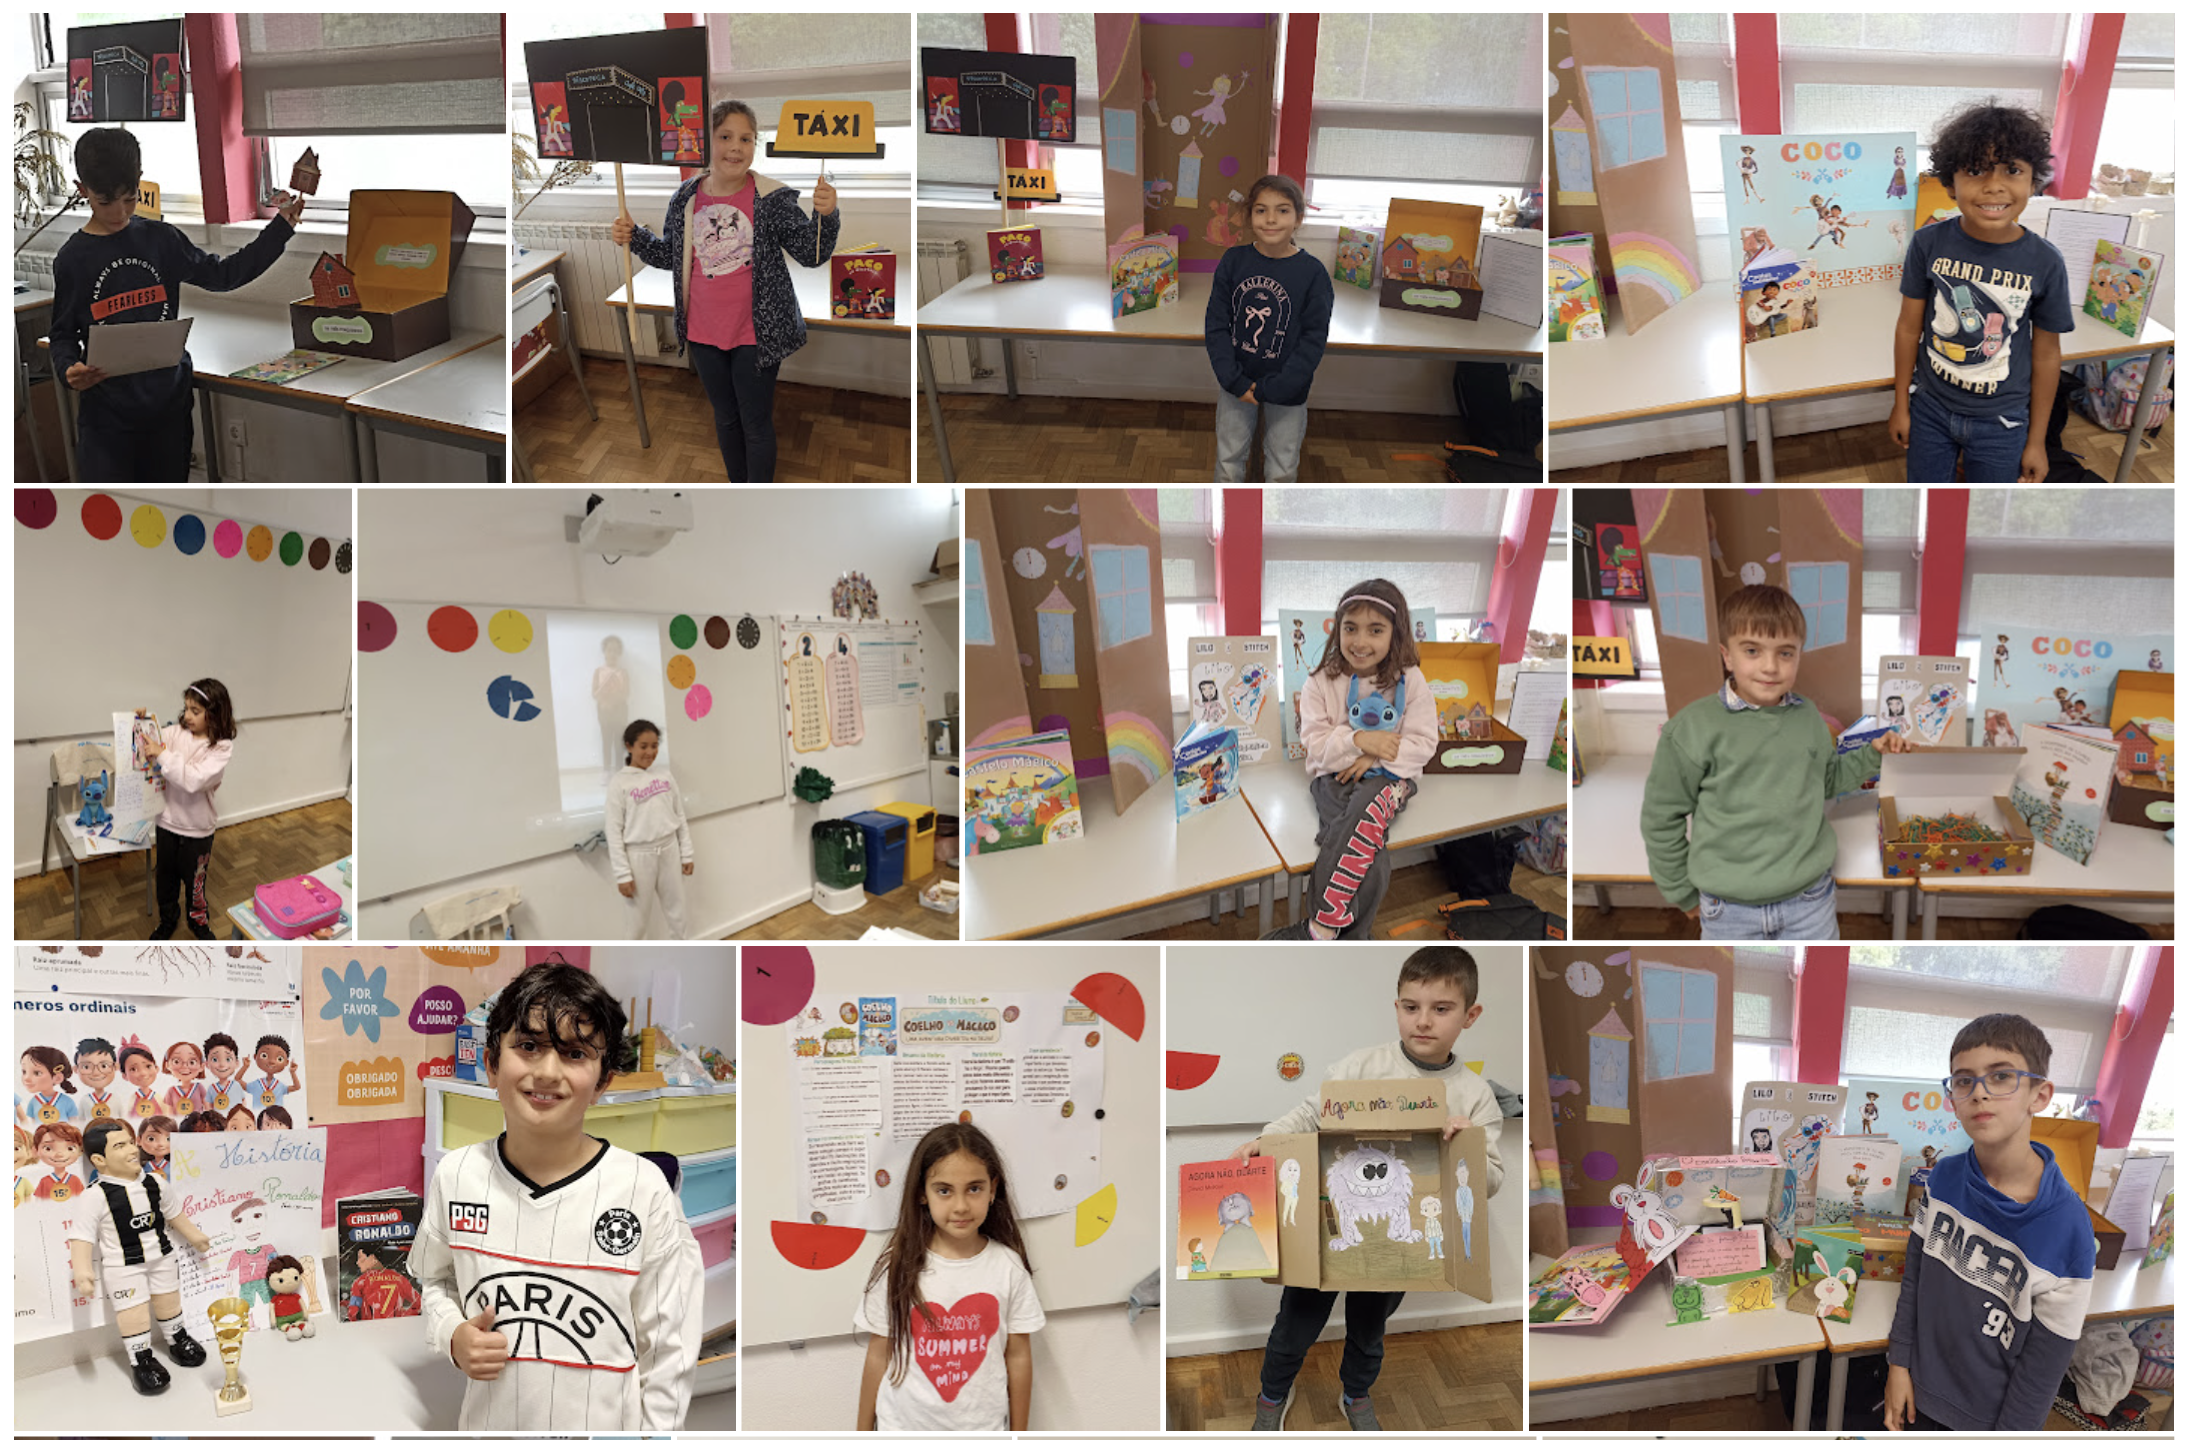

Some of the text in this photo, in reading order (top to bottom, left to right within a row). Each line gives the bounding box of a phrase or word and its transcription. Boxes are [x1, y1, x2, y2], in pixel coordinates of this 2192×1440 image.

[793, 109, 859, 137] TÁXI
[1781, 141, 1862, 162] COCO
[137, 189, 155, 208] AXI
[999, 233, 1032, 245] PACO
[843, 259, 883, 271] PACO
[93, 258, 161, 300] ALWAYS BE ORIGINAL
[1931, 257, 2033, 292] GRAND PRIX
[1240, 276, 1288, 302] BALLERINA
[1783, 278, 1810, 290] COCO
[107, 289, 156, 313] FEARLESS
[1930, 358, 1999, 395] WINNER
[802, 635, 848, 656] 2 4
[2031, 636, 2113, 659] COCO
[965, 758, 1008, 778] astelo
[349, 987, 372, 1000] POR
[69, 1000, 137, 1014] ordinais
[343, 1003, 379, 1016] FAVOR
[425, 1000, 453, 1011] POSSO
[862, 1002, 892, 1013] COELHO
[417, 1014, 459, 1025] AJUDAR?
[862, 1014, 892, 1023] MACACO
[904, 1019, 997, 1033] COELHO MACACO
[346, 1072, 398, 1084] OBRIGADO
[346, 1086, 398, 1099] OBRIGADA
[1753, 1089, 1773, 1098] LILO
[1321, 1099, 1367, 1120] Agora
[1396, 1095, 1439, 1112] Duarte
[1902, 1091, 1956, 1113] COC
[215, 1134, 324, 1169] História
[1188, 1172, 1215, 1181] AGORA
[1236, 1166, 1267, 1178] DUARTE
[182, 1177, 321, 1218] Cristiano Ronaldo
[130, 1212, 155, 1229] CR7
[351, 1211, 399, 1225] CRISTIANO
[451, 1204, 488, 1232] PSG
[608, 1210, 631, 1219] Paris
[355, 1224, 411, 1241] RONALDO
[249, 1262, 257, 1276] 7
[1926, 1211, 2029, 1311] RACER
[113, 1288, 136, 1300] CR7
[380, 1284, 397, 1315] 7
[476, 1282, 605, 1340] PARIS
[918, 1334, 987, 1357] SUMMER
[945, 1359, 961, 1370] my
